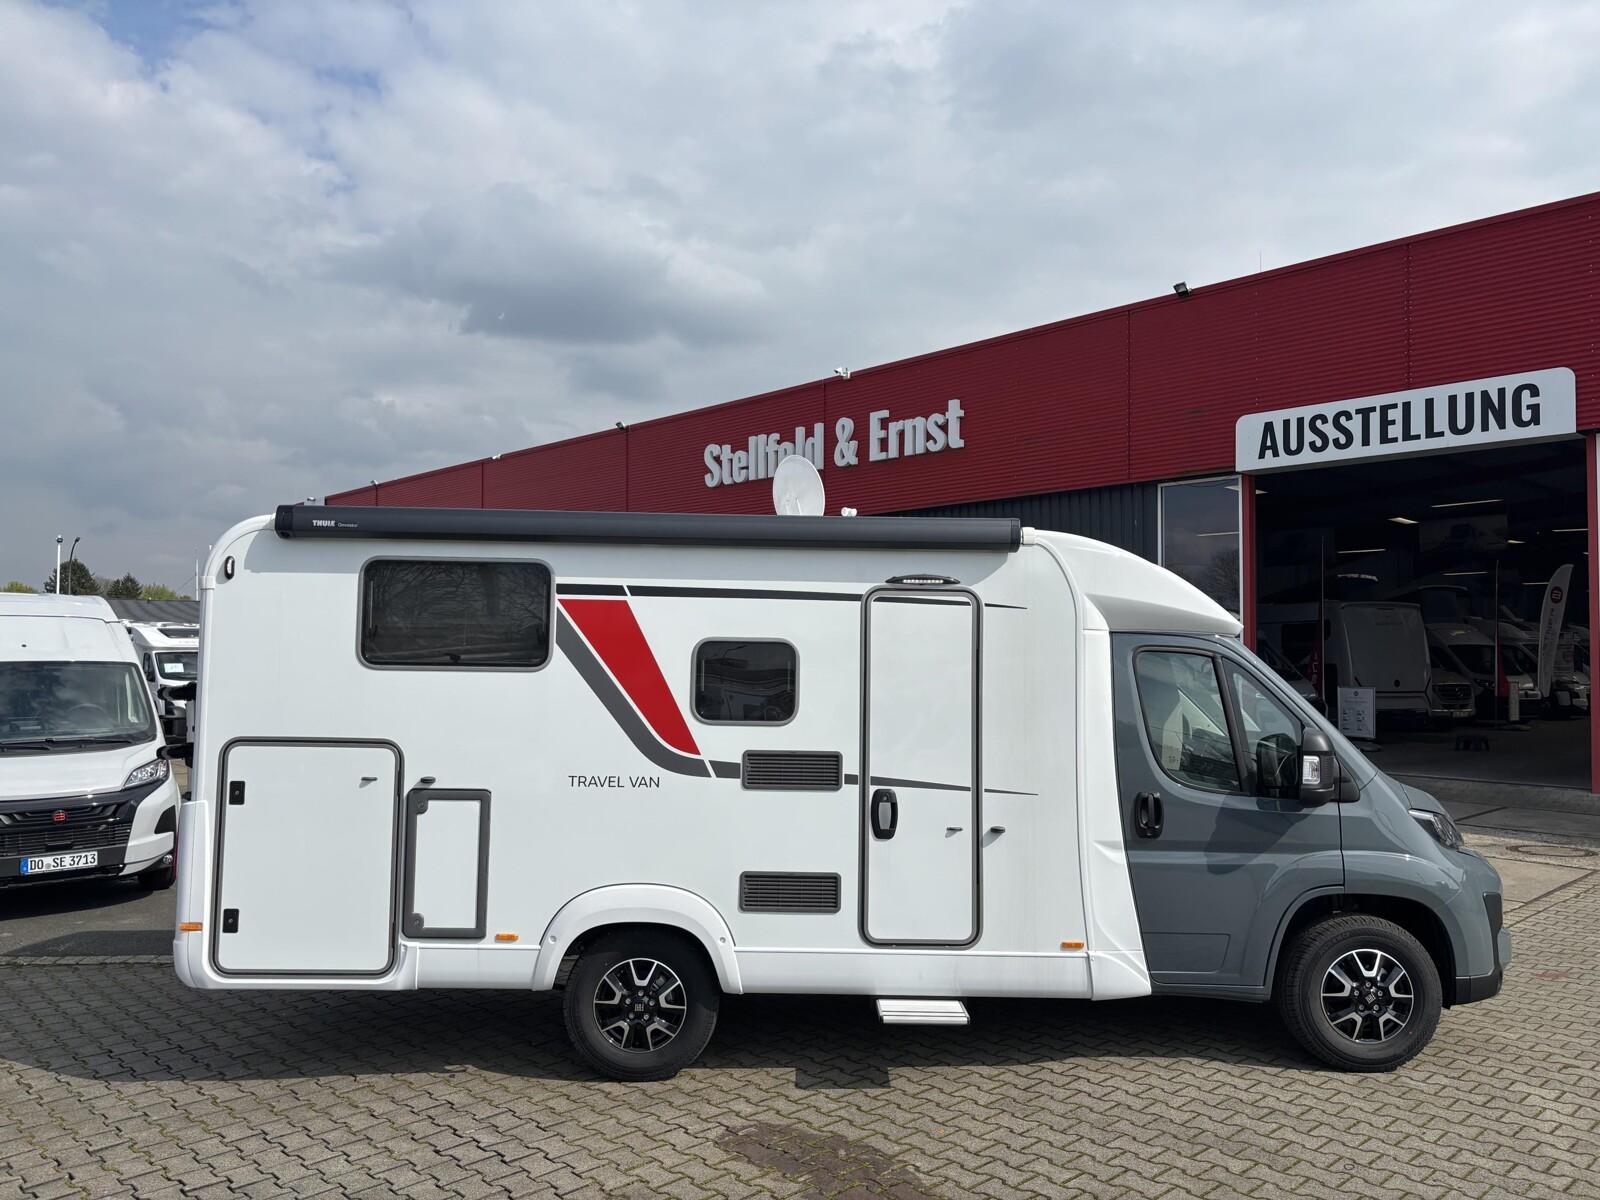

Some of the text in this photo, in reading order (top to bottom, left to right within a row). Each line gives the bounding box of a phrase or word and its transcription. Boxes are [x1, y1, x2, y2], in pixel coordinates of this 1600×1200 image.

[833, 417, 859, 467] &
[869, 398, 965, 462] Ernst
[1257, 383, 1541, 460] AUSSTELLUNG
[568, 775, 660, 788] TRAVEL VAN
[29, 853, 96, 871] DO SE 3713
